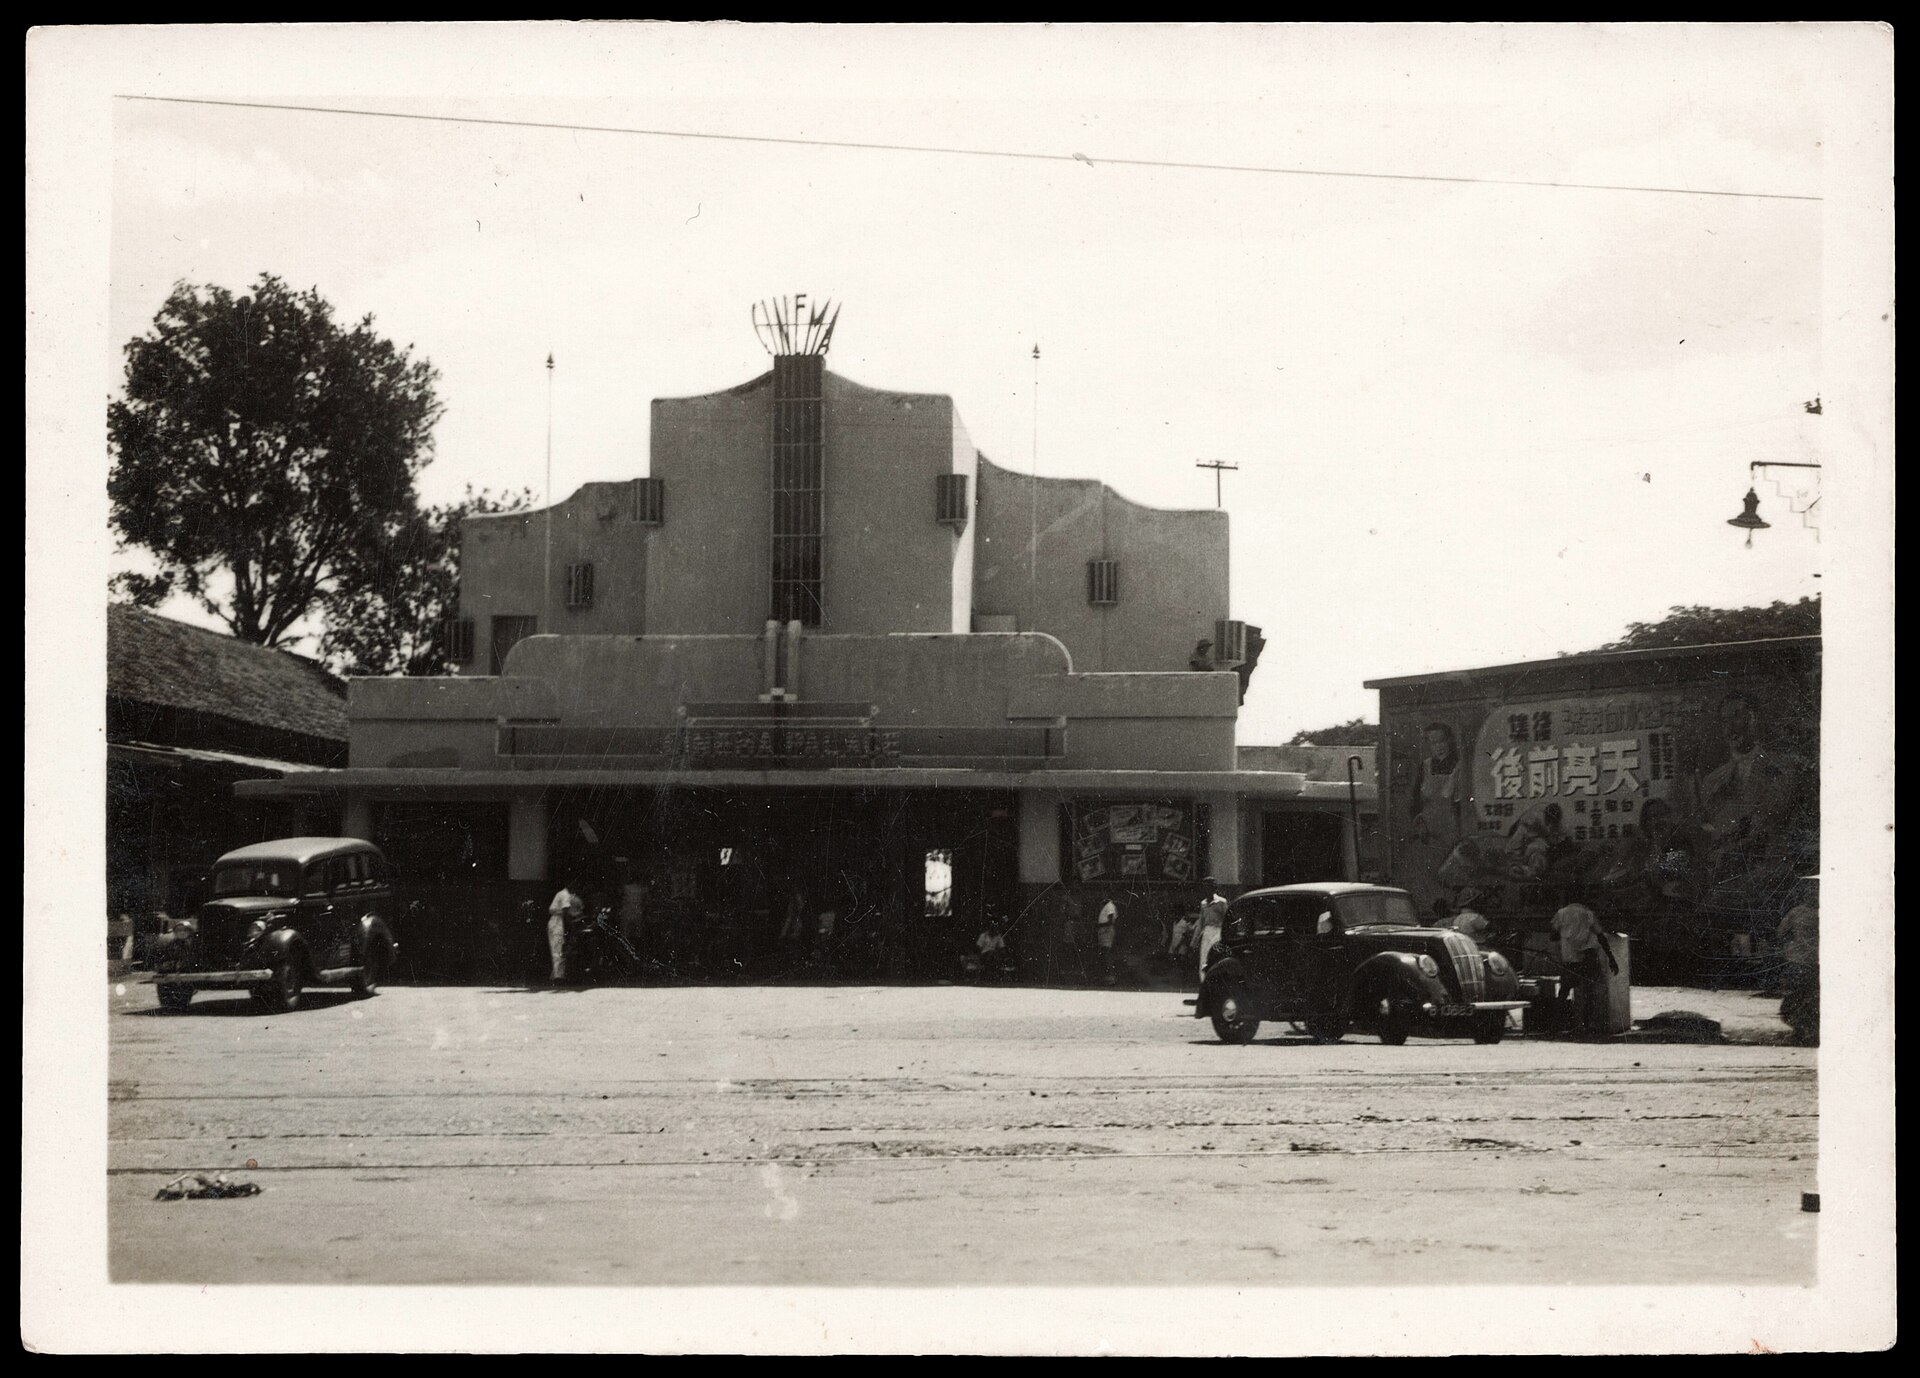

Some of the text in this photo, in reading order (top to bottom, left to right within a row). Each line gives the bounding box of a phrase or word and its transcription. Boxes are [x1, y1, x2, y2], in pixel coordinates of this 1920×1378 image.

[785, 730, 900, 755] PALACE
[1490, 738, 1641, 799] 天亮前後
